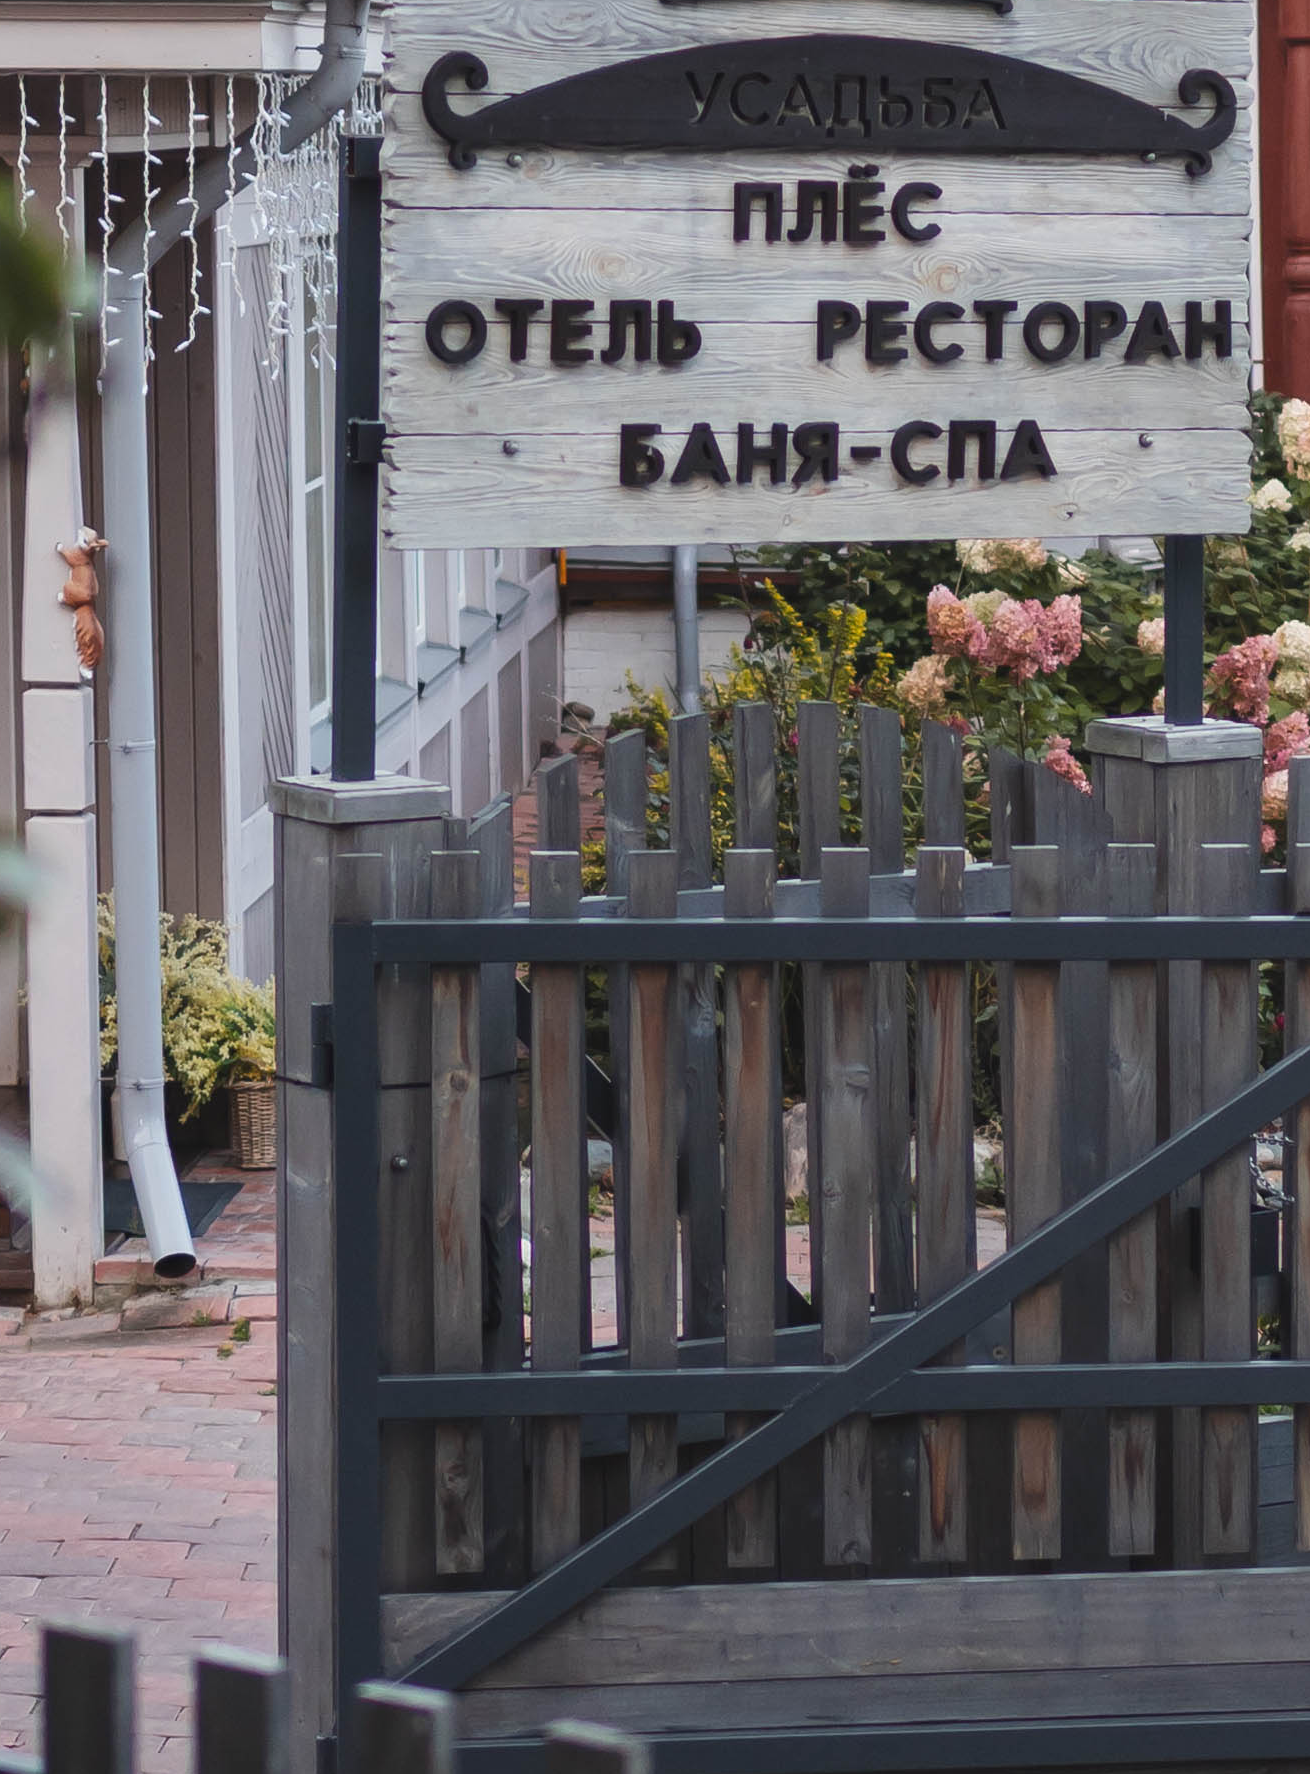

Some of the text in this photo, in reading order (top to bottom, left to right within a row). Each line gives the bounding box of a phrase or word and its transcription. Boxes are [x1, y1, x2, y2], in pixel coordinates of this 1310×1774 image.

[685, 70, 1010, 138] УСАДЬБА
[732, 163, 944, 244] ПЛЁС
[425, 298, 1234, 365] ОТЕЛЬ РЕСТОРАН
[618, 419, 1058, 487] БАНЯ-СПА
